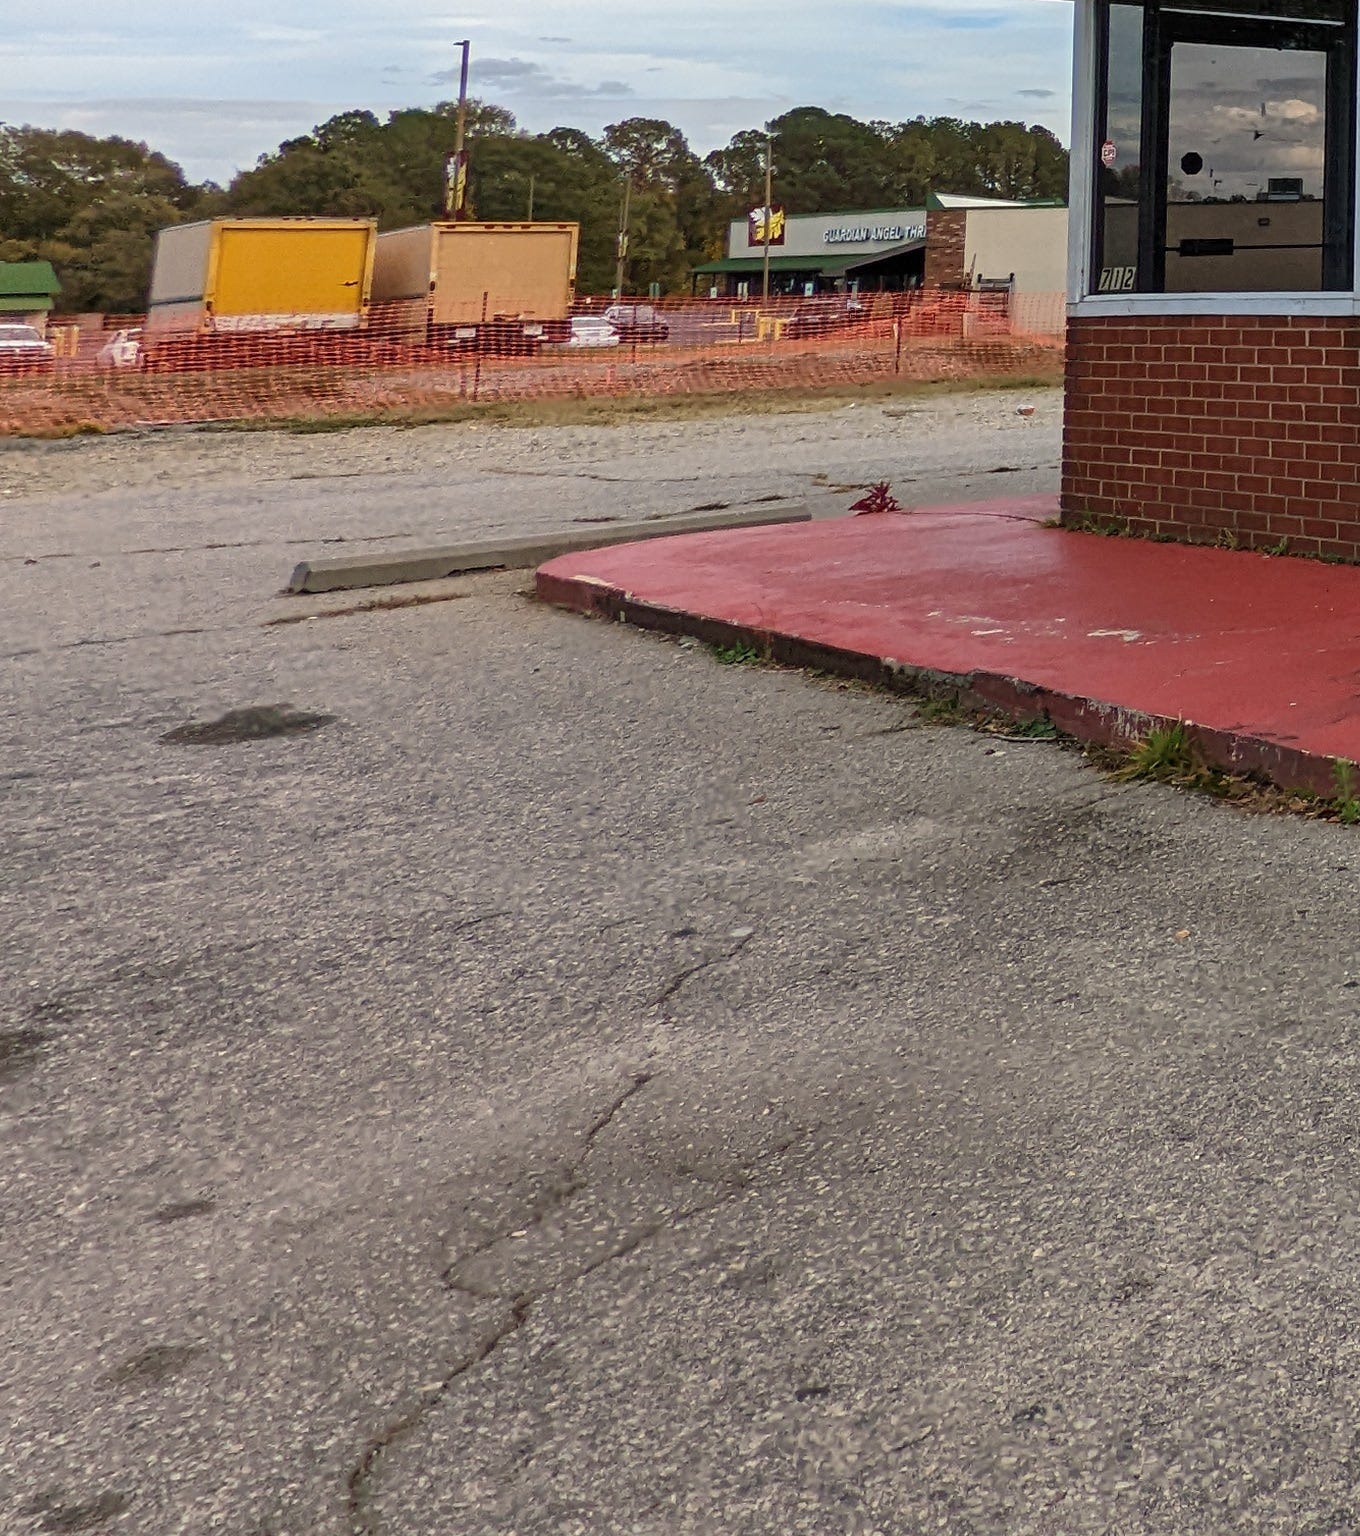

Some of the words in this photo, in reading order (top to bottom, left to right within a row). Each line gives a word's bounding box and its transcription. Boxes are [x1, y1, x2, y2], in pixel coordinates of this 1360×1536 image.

[823, 227, 867, 242] GUARDIAN
[870, 226, 902, 239] ANGEL
[1100, 268, 1134, 289] 712
